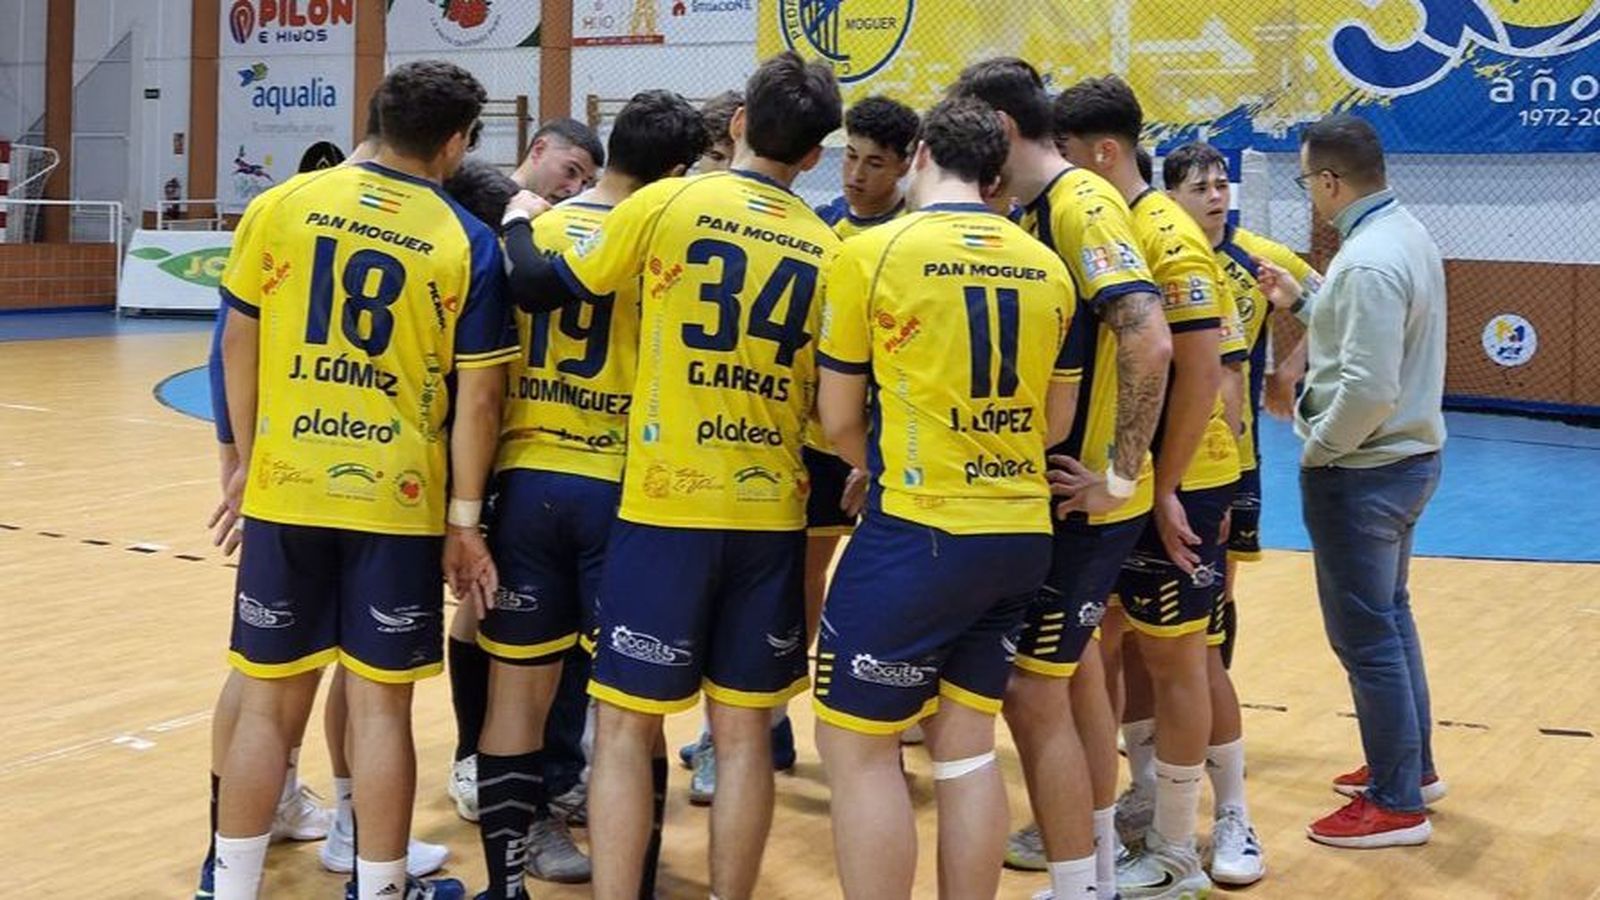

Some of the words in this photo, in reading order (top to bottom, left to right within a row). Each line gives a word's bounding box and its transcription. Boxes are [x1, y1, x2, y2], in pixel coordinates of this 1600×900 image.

[258, 31, 270, 44] E
[276, 29, 329, 43] HIJOS
[844, 17, 897, 31] MOGUER
[252, 77, 336, 115] aqualia
[305, 212, 346, 230] PAN
[350, 220, 435, 256] MOGUER
[696, 214, 740, 234] PAN
[742, 226, 825, 259] MOGUER
[923, 262, 965, 277] PAN
[969, 263, 1048, 282] MOGUER
[304, 235, 407, 358] 18
[681, 237, 820, 368] 34
[528, 290, 617, 379] 19
[962, 286, 1020, 400] 11
[288, 355, 308, 380] J.
[519, 375, 633, 416] DOMÍNGUEZ
[292, 408, 395, 444] platero
[697, 414, 784, 446] platero
[949, 407, 967, 433] J.
[971, 402, 1034, 434] LÓPEZ
